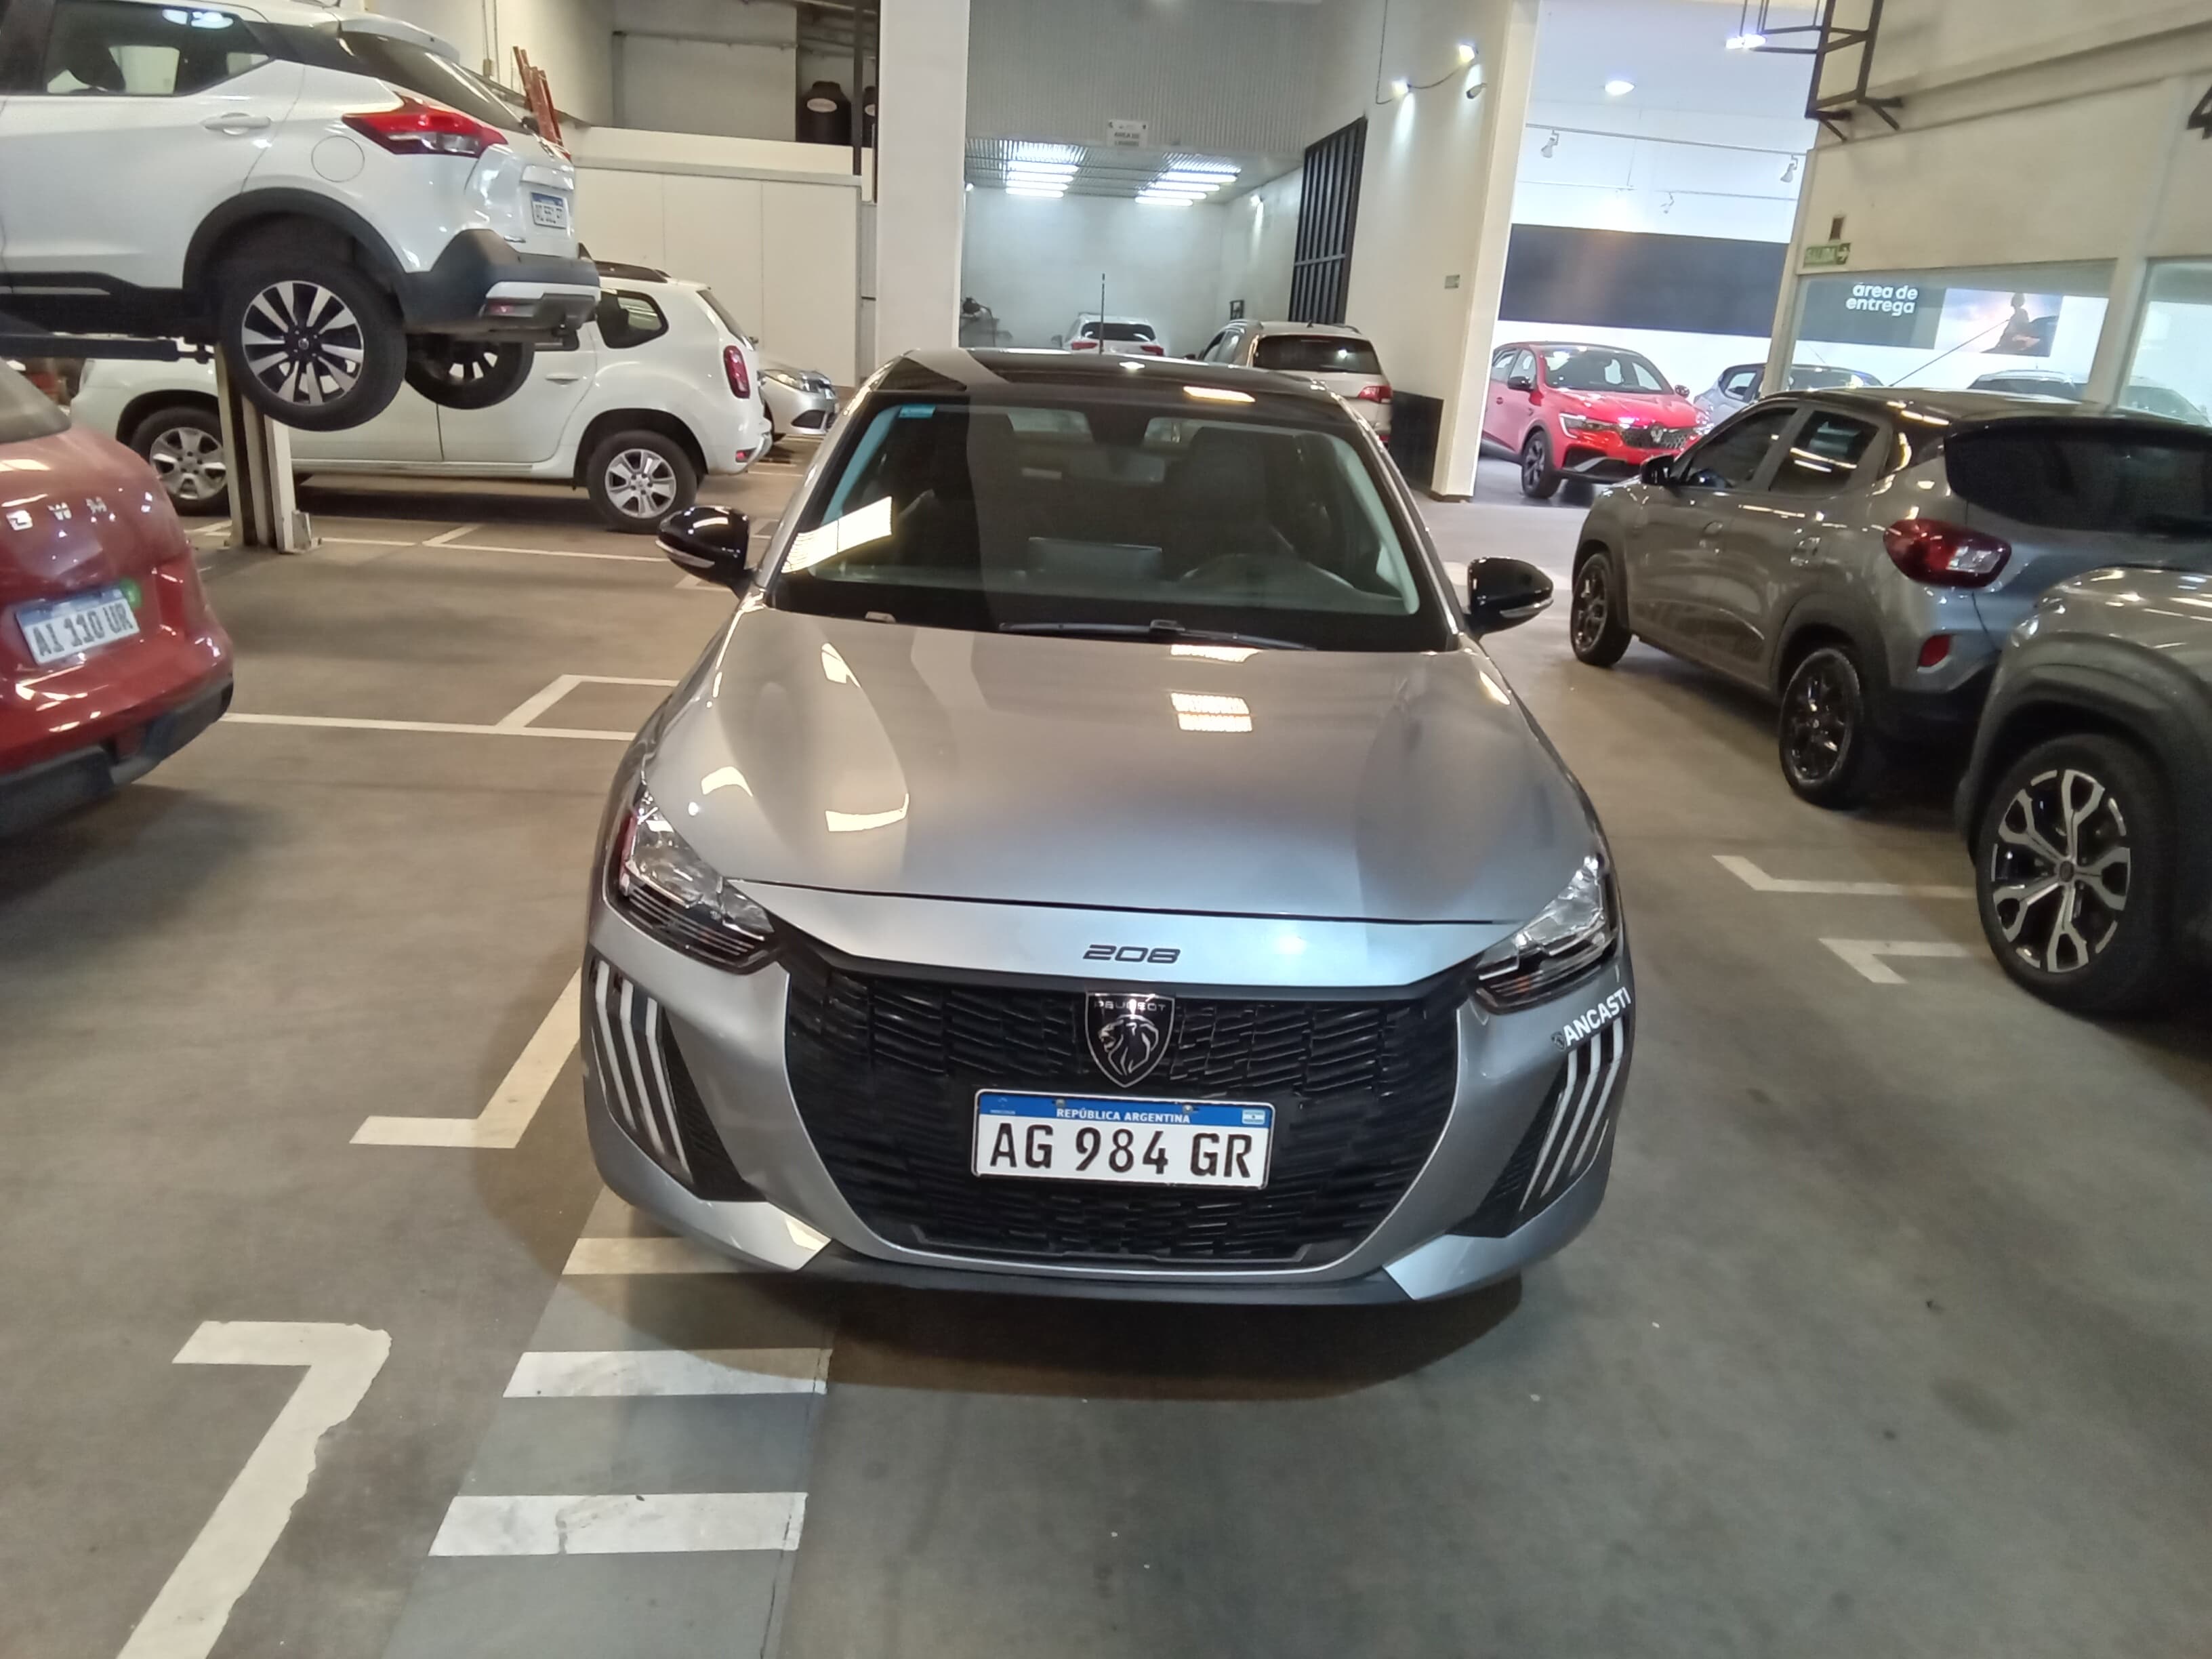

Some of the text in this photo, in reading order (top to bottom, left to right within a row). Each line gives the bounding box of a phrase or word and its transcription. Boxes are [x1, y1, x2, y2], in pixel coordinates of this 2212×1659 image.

[1852, 282, 1919, 300] área de
[1845, 298, 1916, 316] entrega
[63, 611, 105, 647] 110
[1082, 944, 1181, 964] 208
[1094, 1000, 1166, 1011] PEUEOT
[1563, 987, 1631, 1046] ANCASTI
[1056, 1107, 1191, 1124] REPÚBLICA ARGENTINA
[989, 1122, 1253, 1179] AG 984 GR
